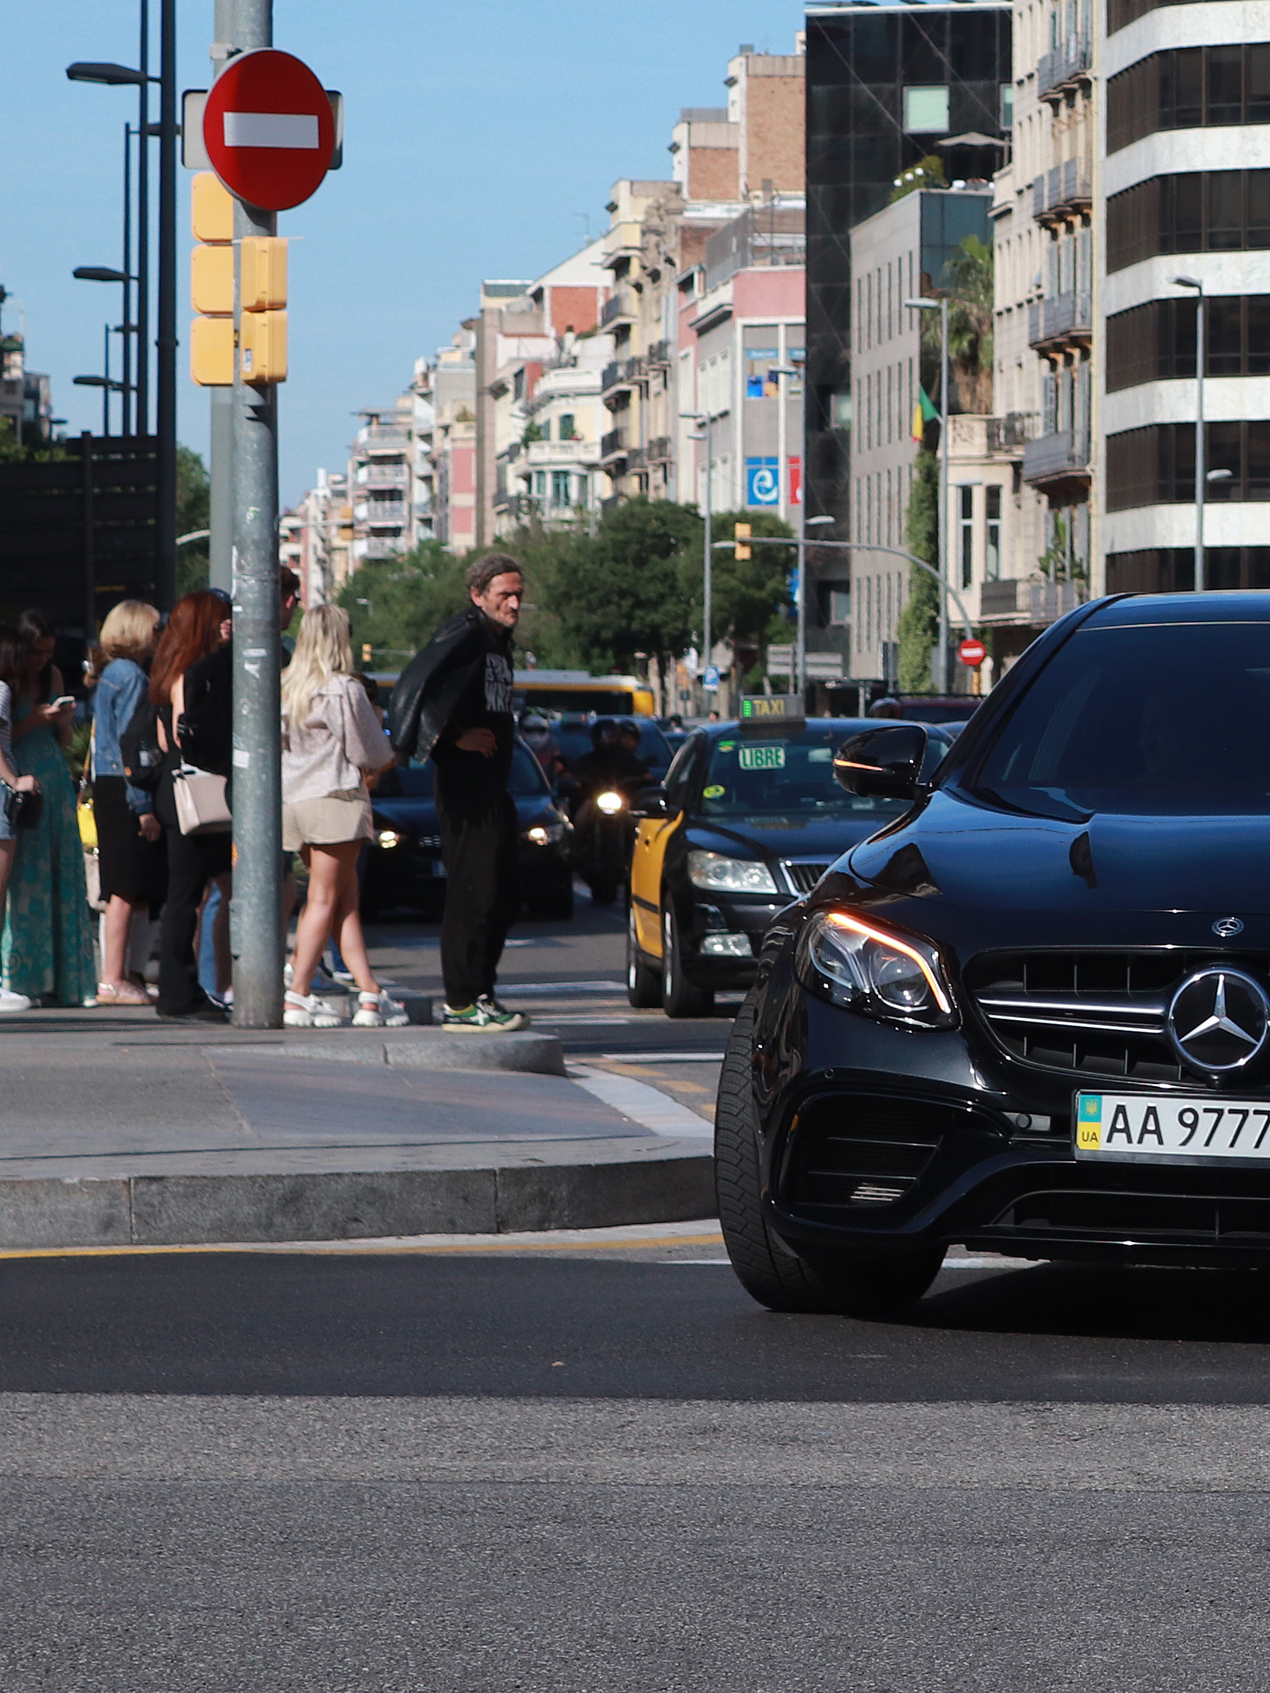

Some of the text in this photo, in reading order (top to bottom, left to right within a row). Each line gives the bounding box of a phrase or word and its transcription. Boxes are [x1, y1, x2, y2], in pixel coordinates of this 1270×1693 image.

[753, 699, 785, 716] TAXI
[742, 748, 782, 767] LIBRE
[1106, 1103, 1164, 1146] AA
[1081, 1130, 1099, 1143] UA
